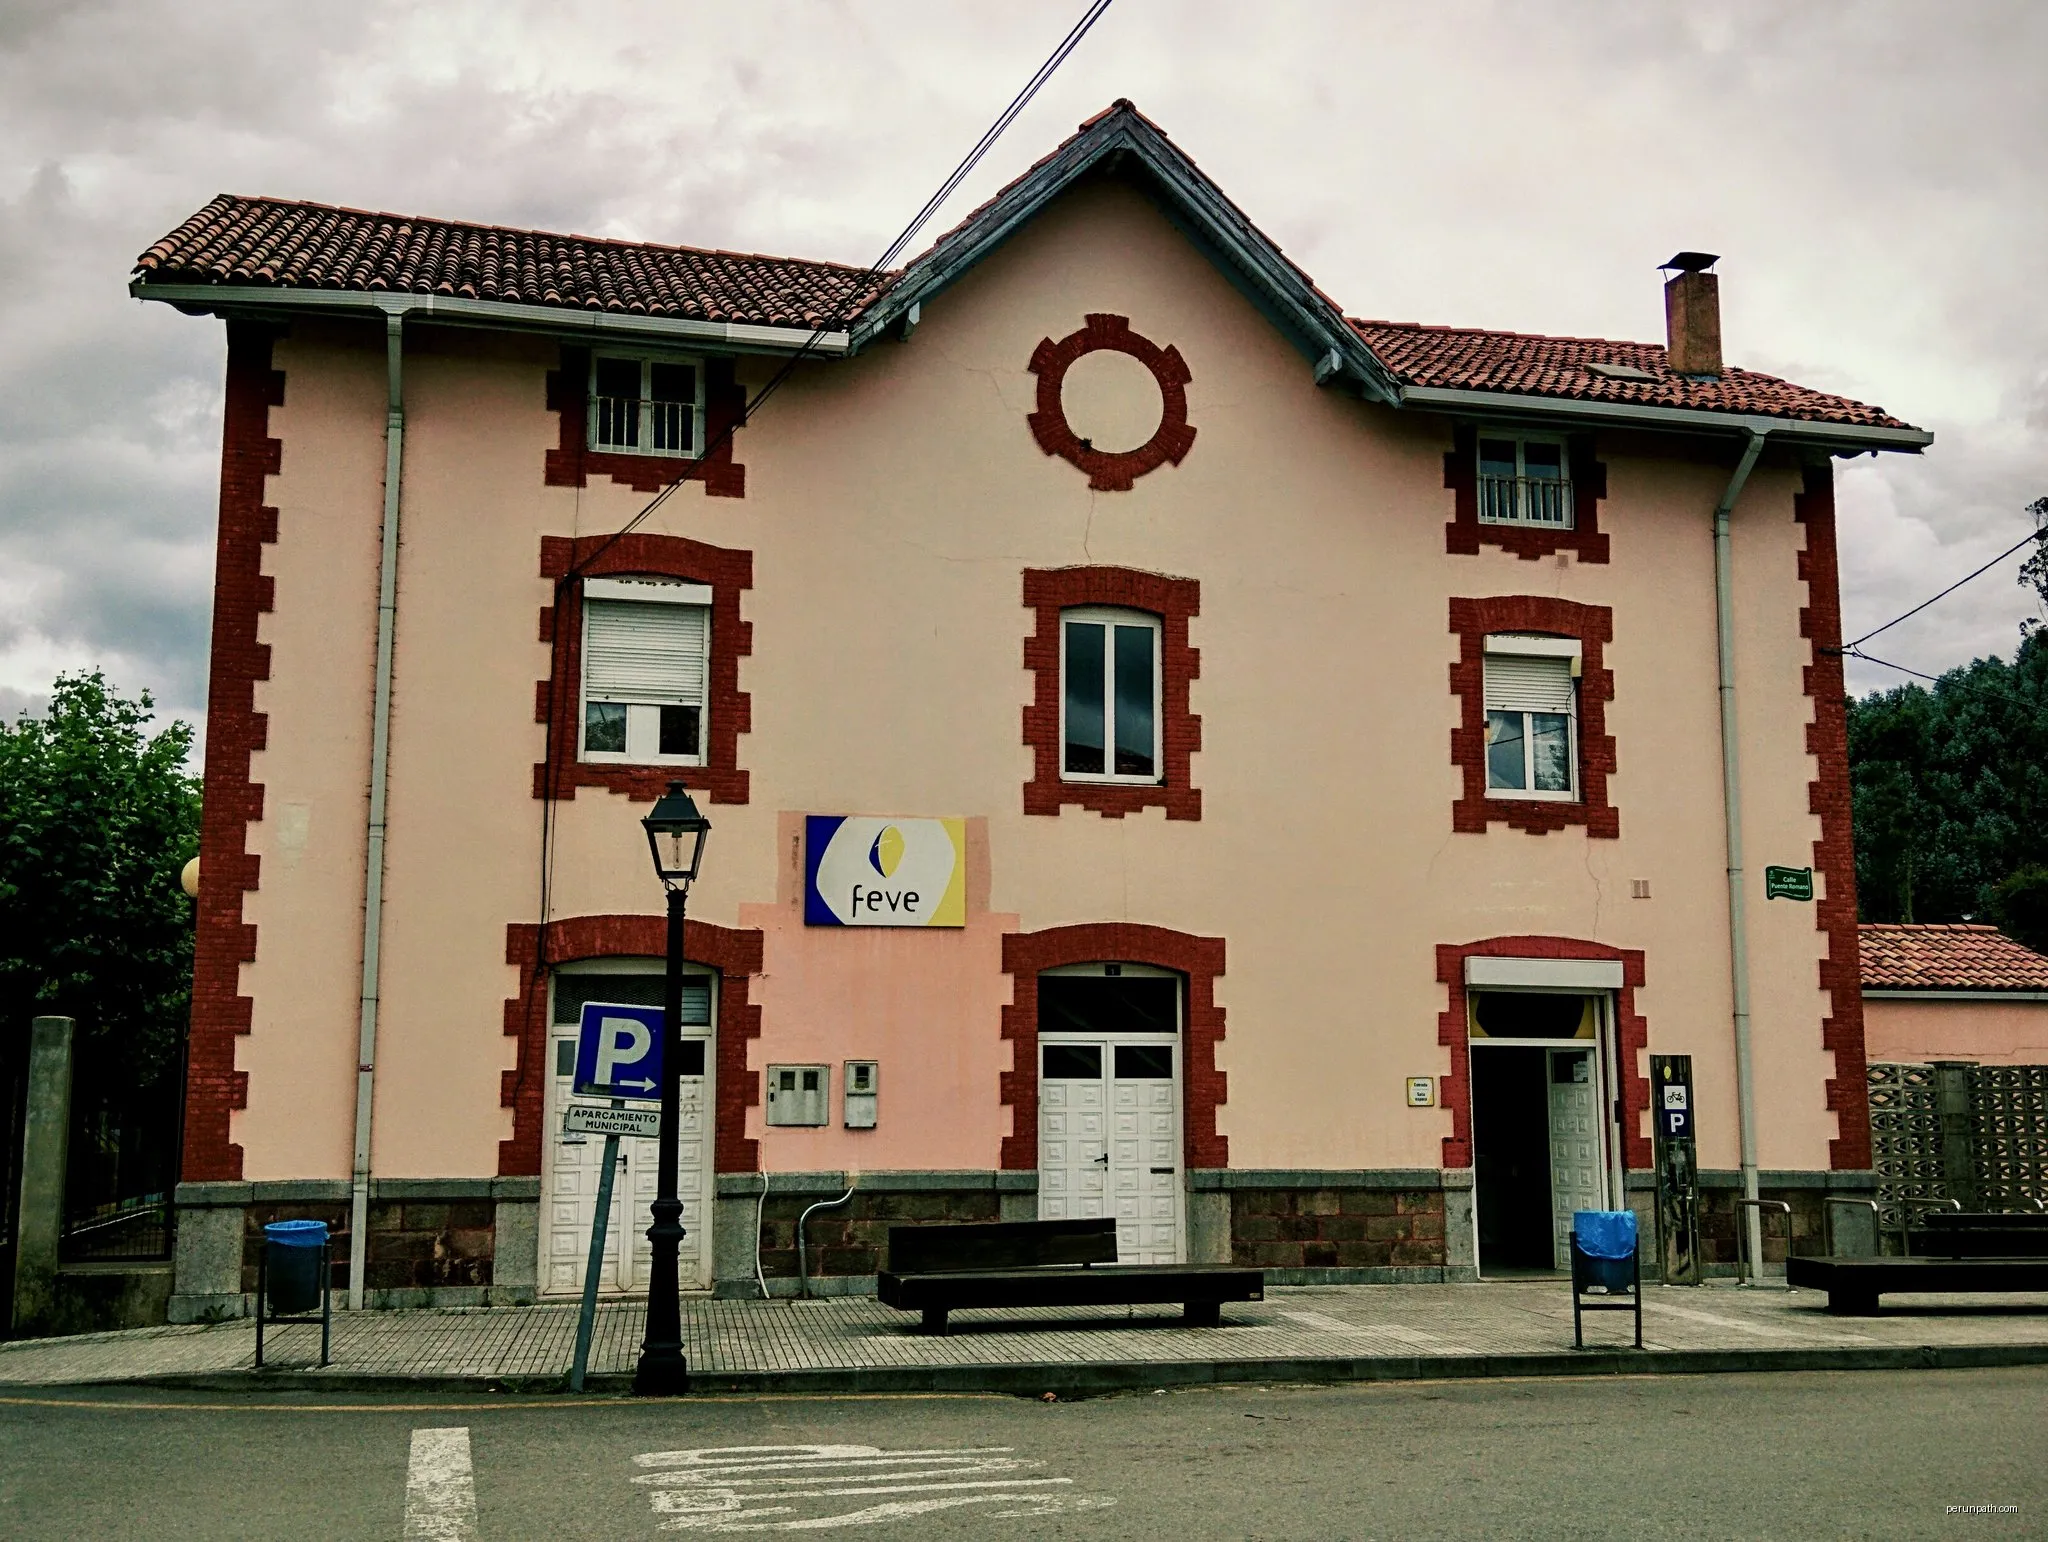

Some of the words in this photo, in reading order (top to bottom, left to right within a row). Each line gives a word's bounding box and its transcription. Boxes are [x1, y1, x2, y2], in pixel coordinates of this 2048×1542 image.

[853, 885, 920, 917] feve
[594, 1017, 651, 1085] P
[573, 1109, 657, 1123] APARCAMIENTO
[1670, 1113, 1685, 1132] P
[585, 1120, 642, 1132] MUNICIPAL
